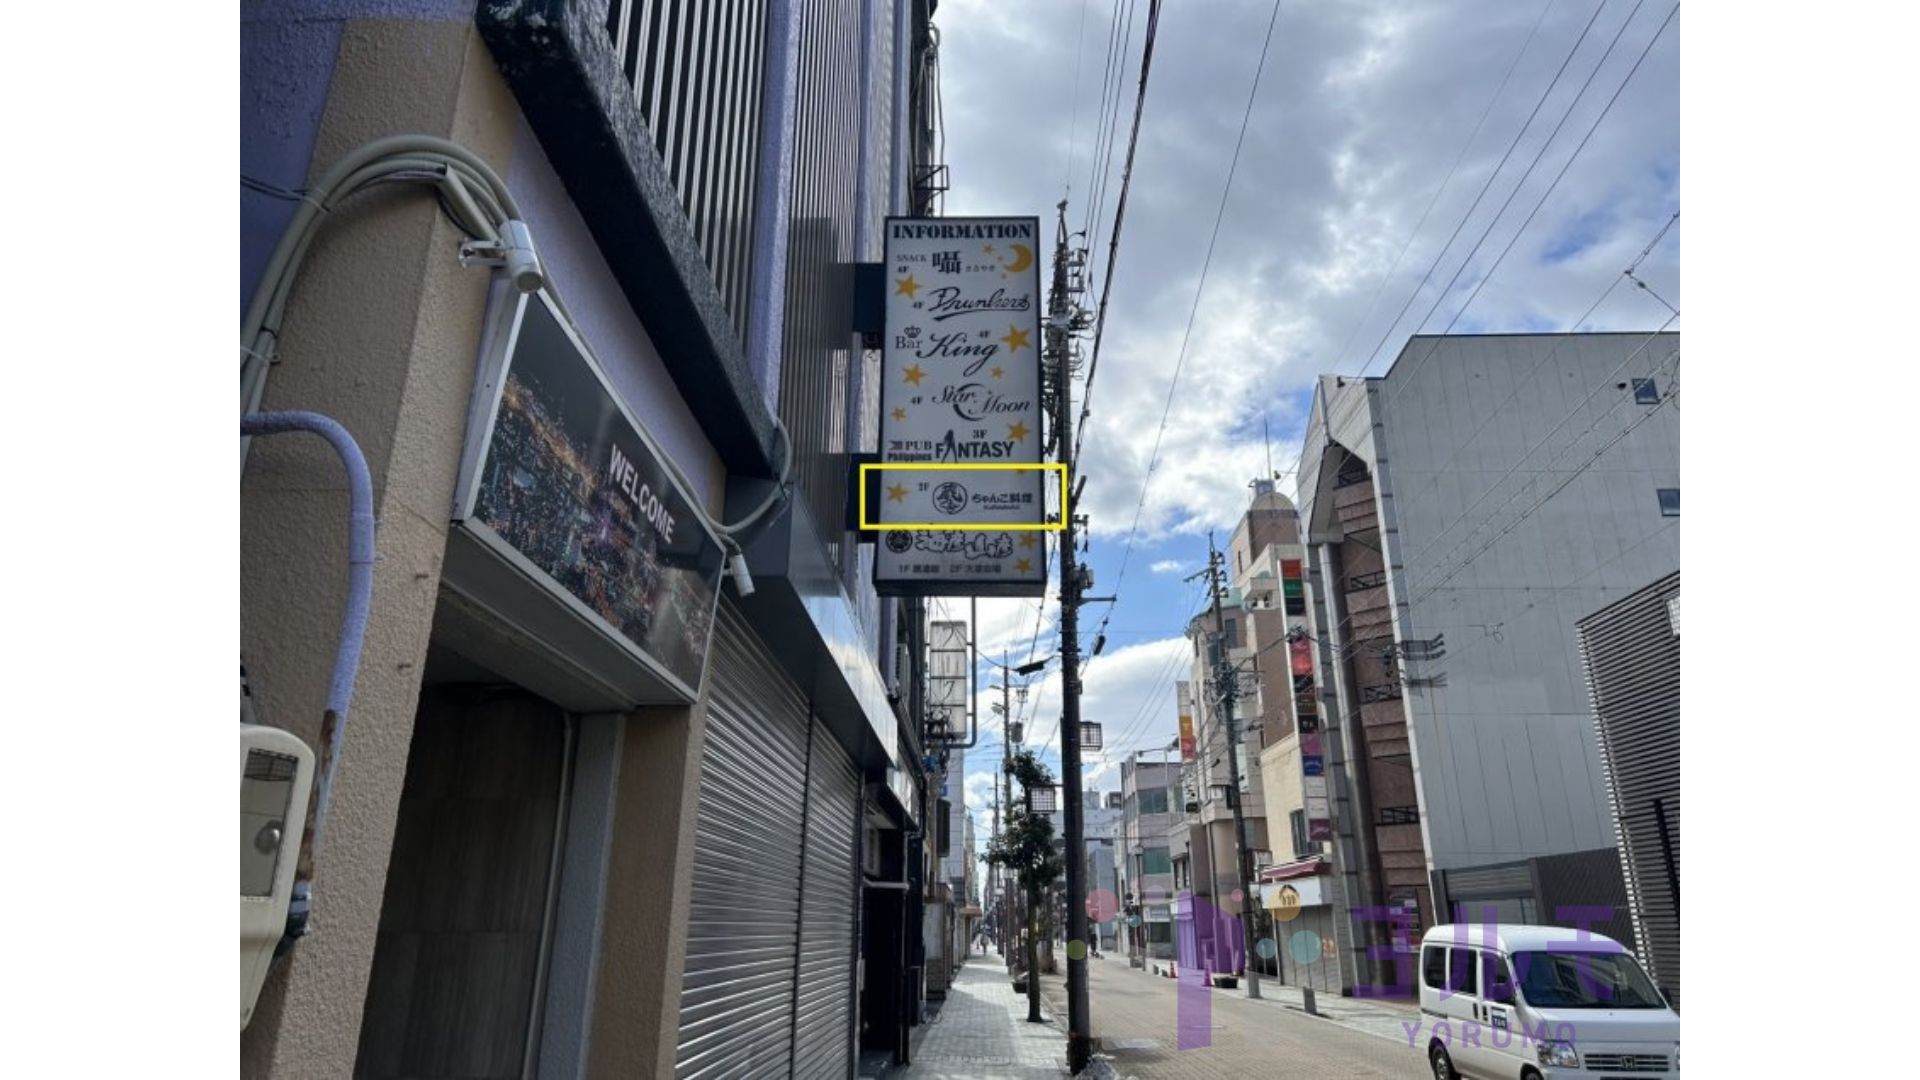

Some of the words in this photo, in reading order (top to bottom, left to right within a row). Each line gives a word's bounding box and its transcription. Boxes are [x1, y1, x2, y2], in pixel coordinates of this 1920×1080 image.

[893, 224, 1031, 239] INFORMATION
[897, 254, 926, 262] SNACK
[895, 335, 923, 349] Bar
[916, 332, 999, 377] King
[932, 385, 977, 403] Star
[968, 390, 1030, 414] Moon
[973, 429, 987, 438] 3F
[905, 440, 932, 450] PUB
[935, 432, 1015, 463] FANTASY
[609, 443, 675, 544] WELCOME
